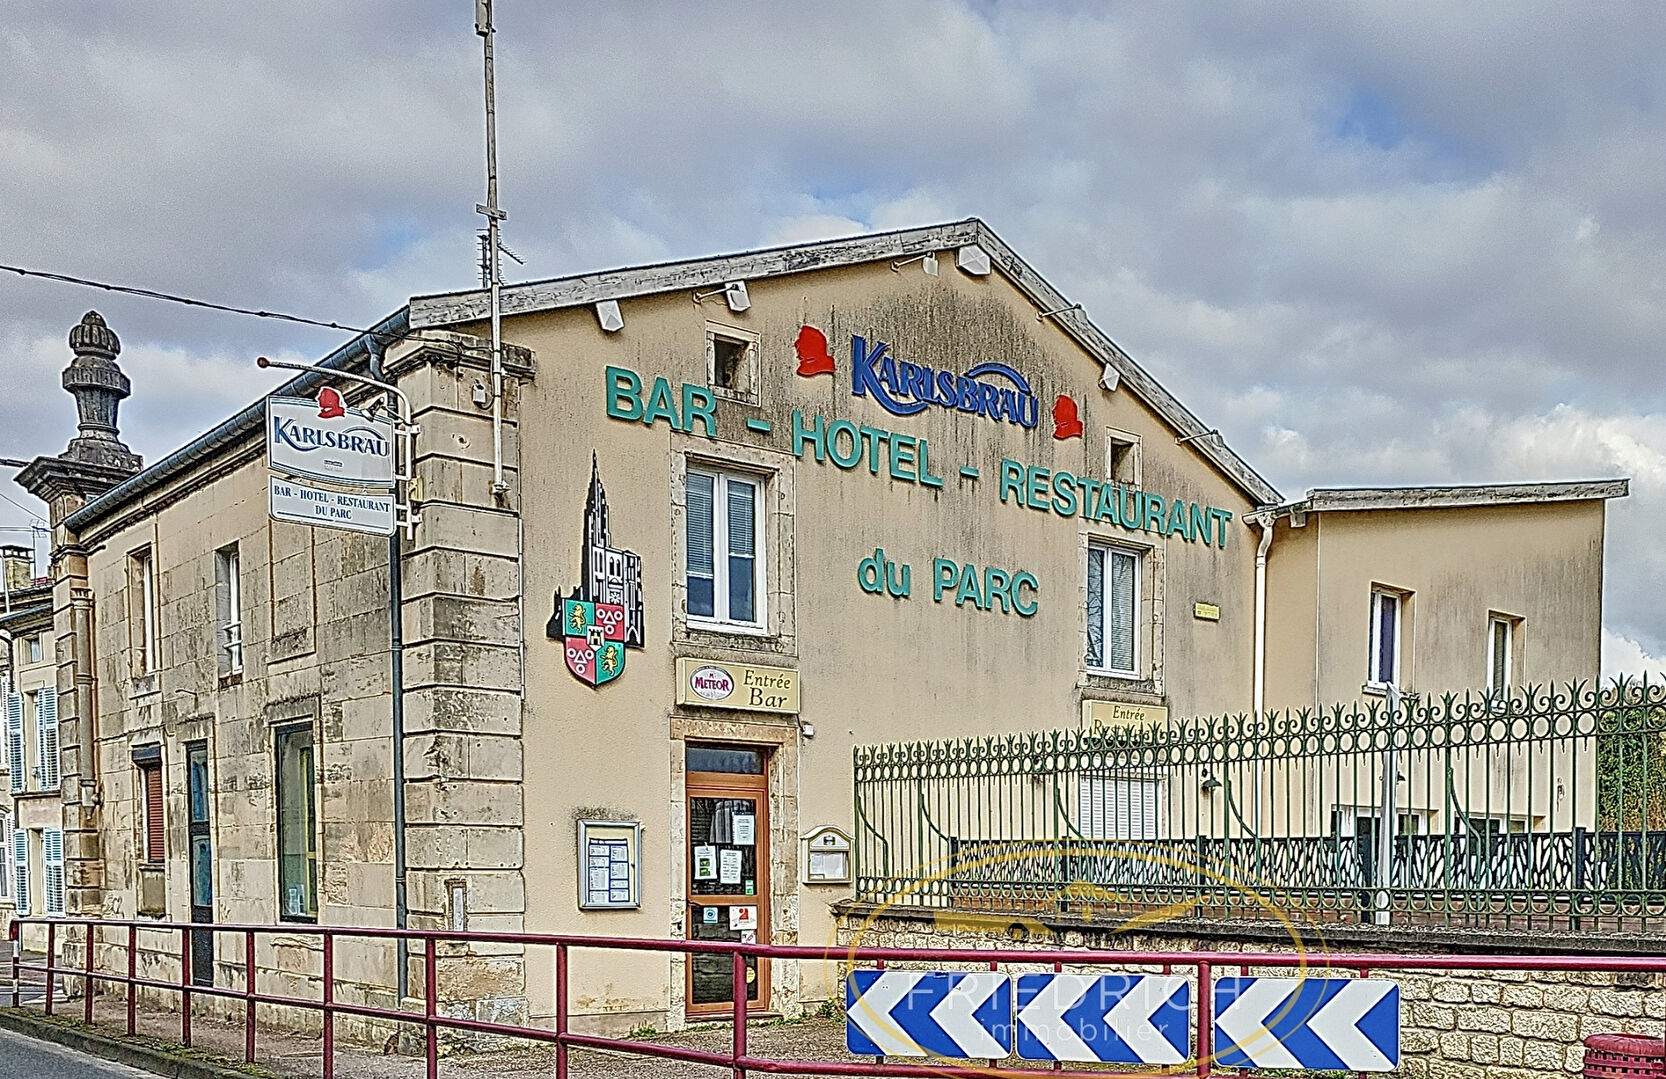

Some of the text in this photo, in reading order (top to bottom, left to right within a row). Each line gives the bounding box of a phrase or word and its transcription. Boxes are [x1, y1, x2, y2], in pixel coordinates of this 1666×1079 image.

[605, 365, 717, 437] BAR
[792, 410, 943, 487] HOTEL
[1000, 458, 1234, 548] RESTAURANT
[274, 485, 292, 497] BAR
[300, 489, 329, 503] HOTEL
[337, 495, 390, 513] RESTAURANT
[315, 505, 352, 520] DU PARC
[858, 548, 1038, 616] du PARC
[694, 676, 730, 692] METEOR
[743, 669, 791, 689] Entrée
[749, 687, 788, 708] Bar
[1112, 705, 1145, 721] Entrée
